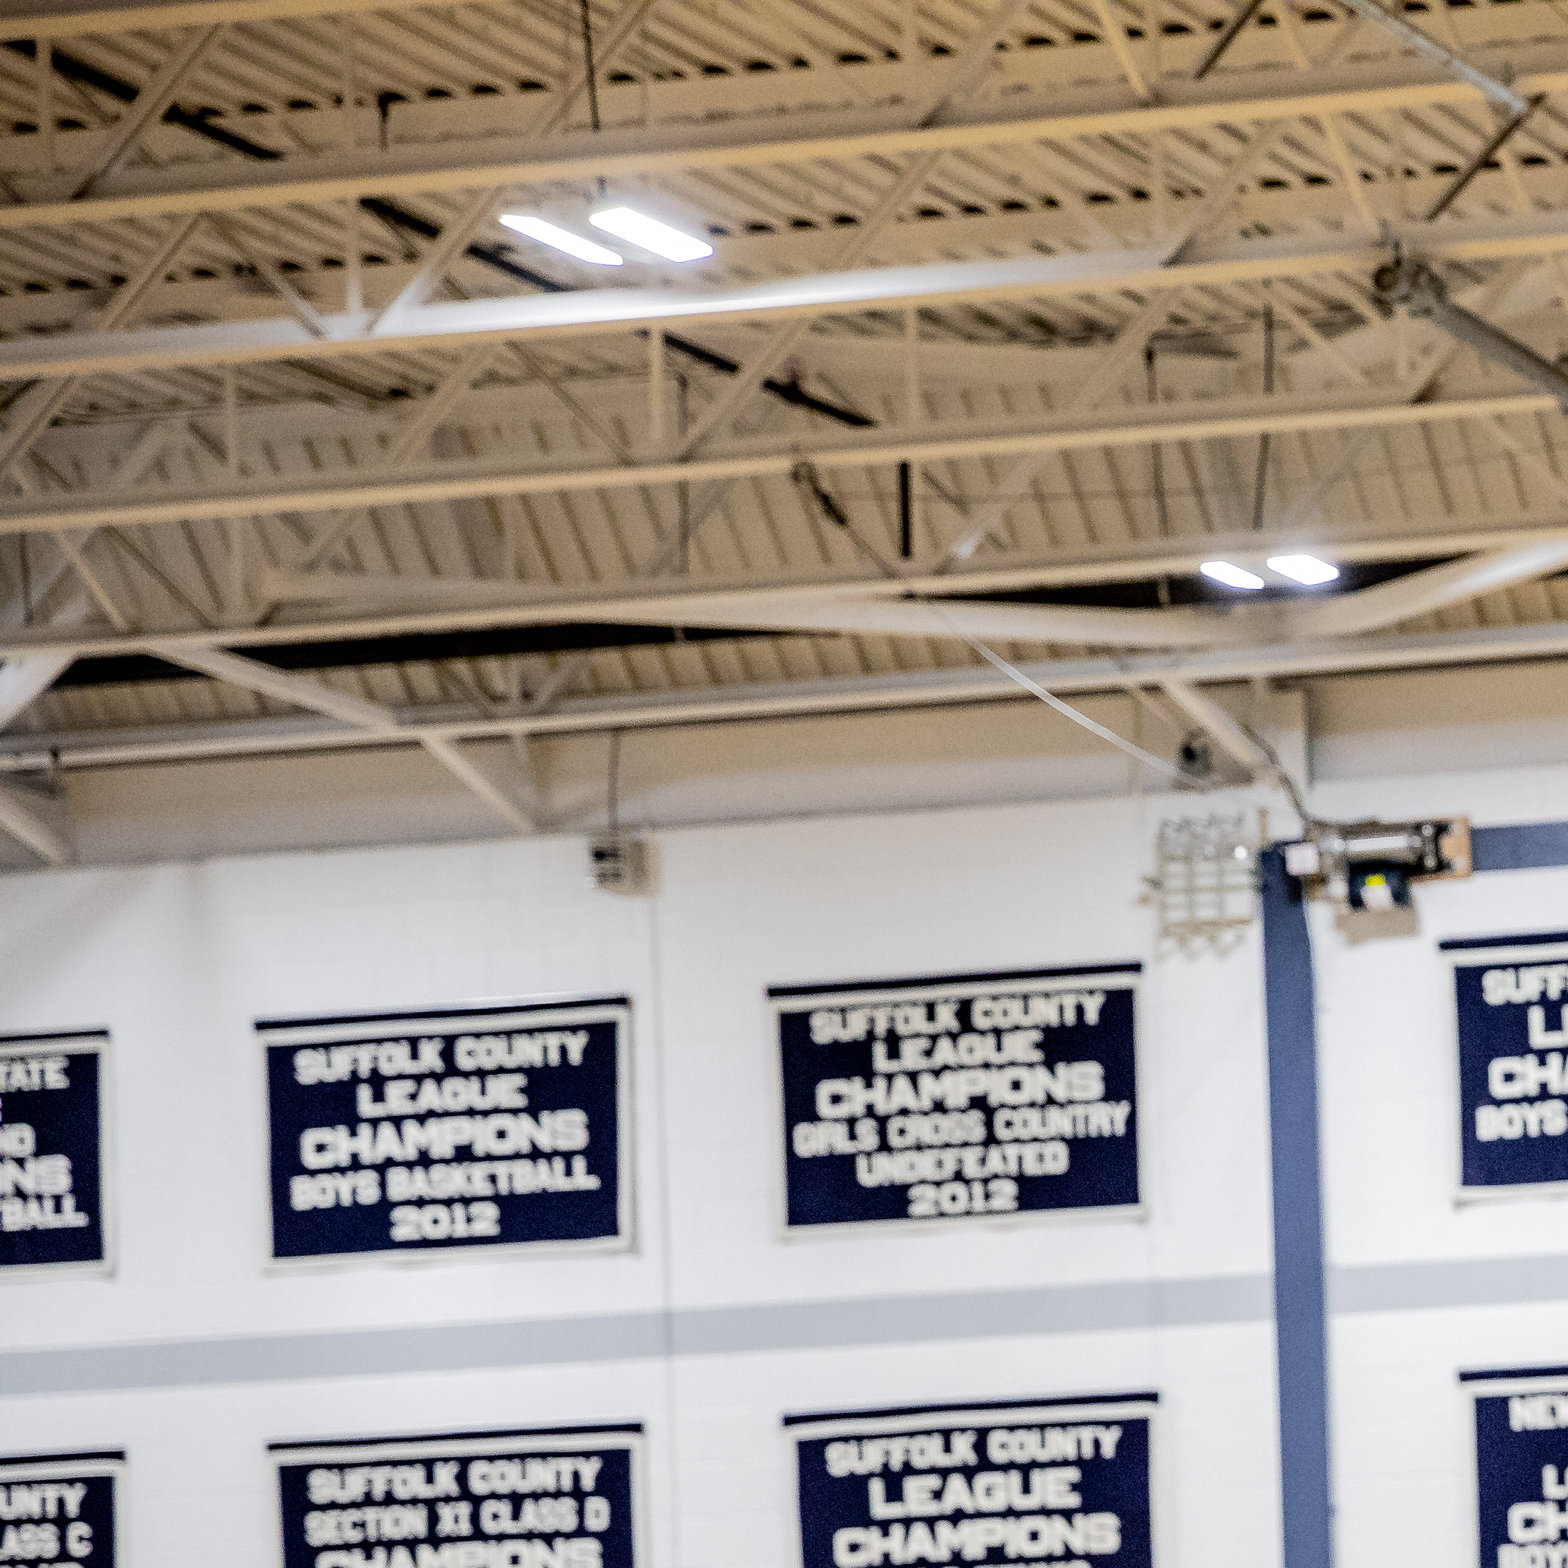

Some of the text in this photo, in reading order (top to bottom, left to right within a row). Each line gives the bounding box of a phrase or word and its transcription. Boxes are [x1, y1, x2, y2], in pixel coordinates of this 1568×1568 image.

[809, 990, 1107, 1044] SUFFOLK COUNTY
[293, 1030, 589, 1086] SUFFOLK COUNTY
[872, 1030, 1046, 1073] LEAGUE
[355, 1072, 529, 1118] LEAGUE
[815, 1061, 1106, 1119] CHAMPIONS
[300, 1108, 590, 1169] CHAMPIONS
[792, 1102, 1132, 1158] GIRLS CROSS COUNTRY
[1474, 1098, 1568, 1142] BOYS
[288, 1156, 600, 1211] BOYS BASKETBALL
[855, 1141, 1070, 1187] UNDEFEATED
[389, 1201, 502, 1242] 2012
[906, 1179, 1020, 1216] 2012
[824, 1425, 1123, 1478] SUFFOLK COUNTY
[306, 1456, 603, 1506] SUFFOLK COUNTY
[868, 1466, 1082, 1520] LEAGUE
[65, 1521, 93, 1558] C
[302, 1502, 428, 1547] SECTION
[436, 1500, 472, 1537] XI
[478, 1497, 578, 1535] CLASS
[832, 1512, 1121, 1568] CHAMPIONS
